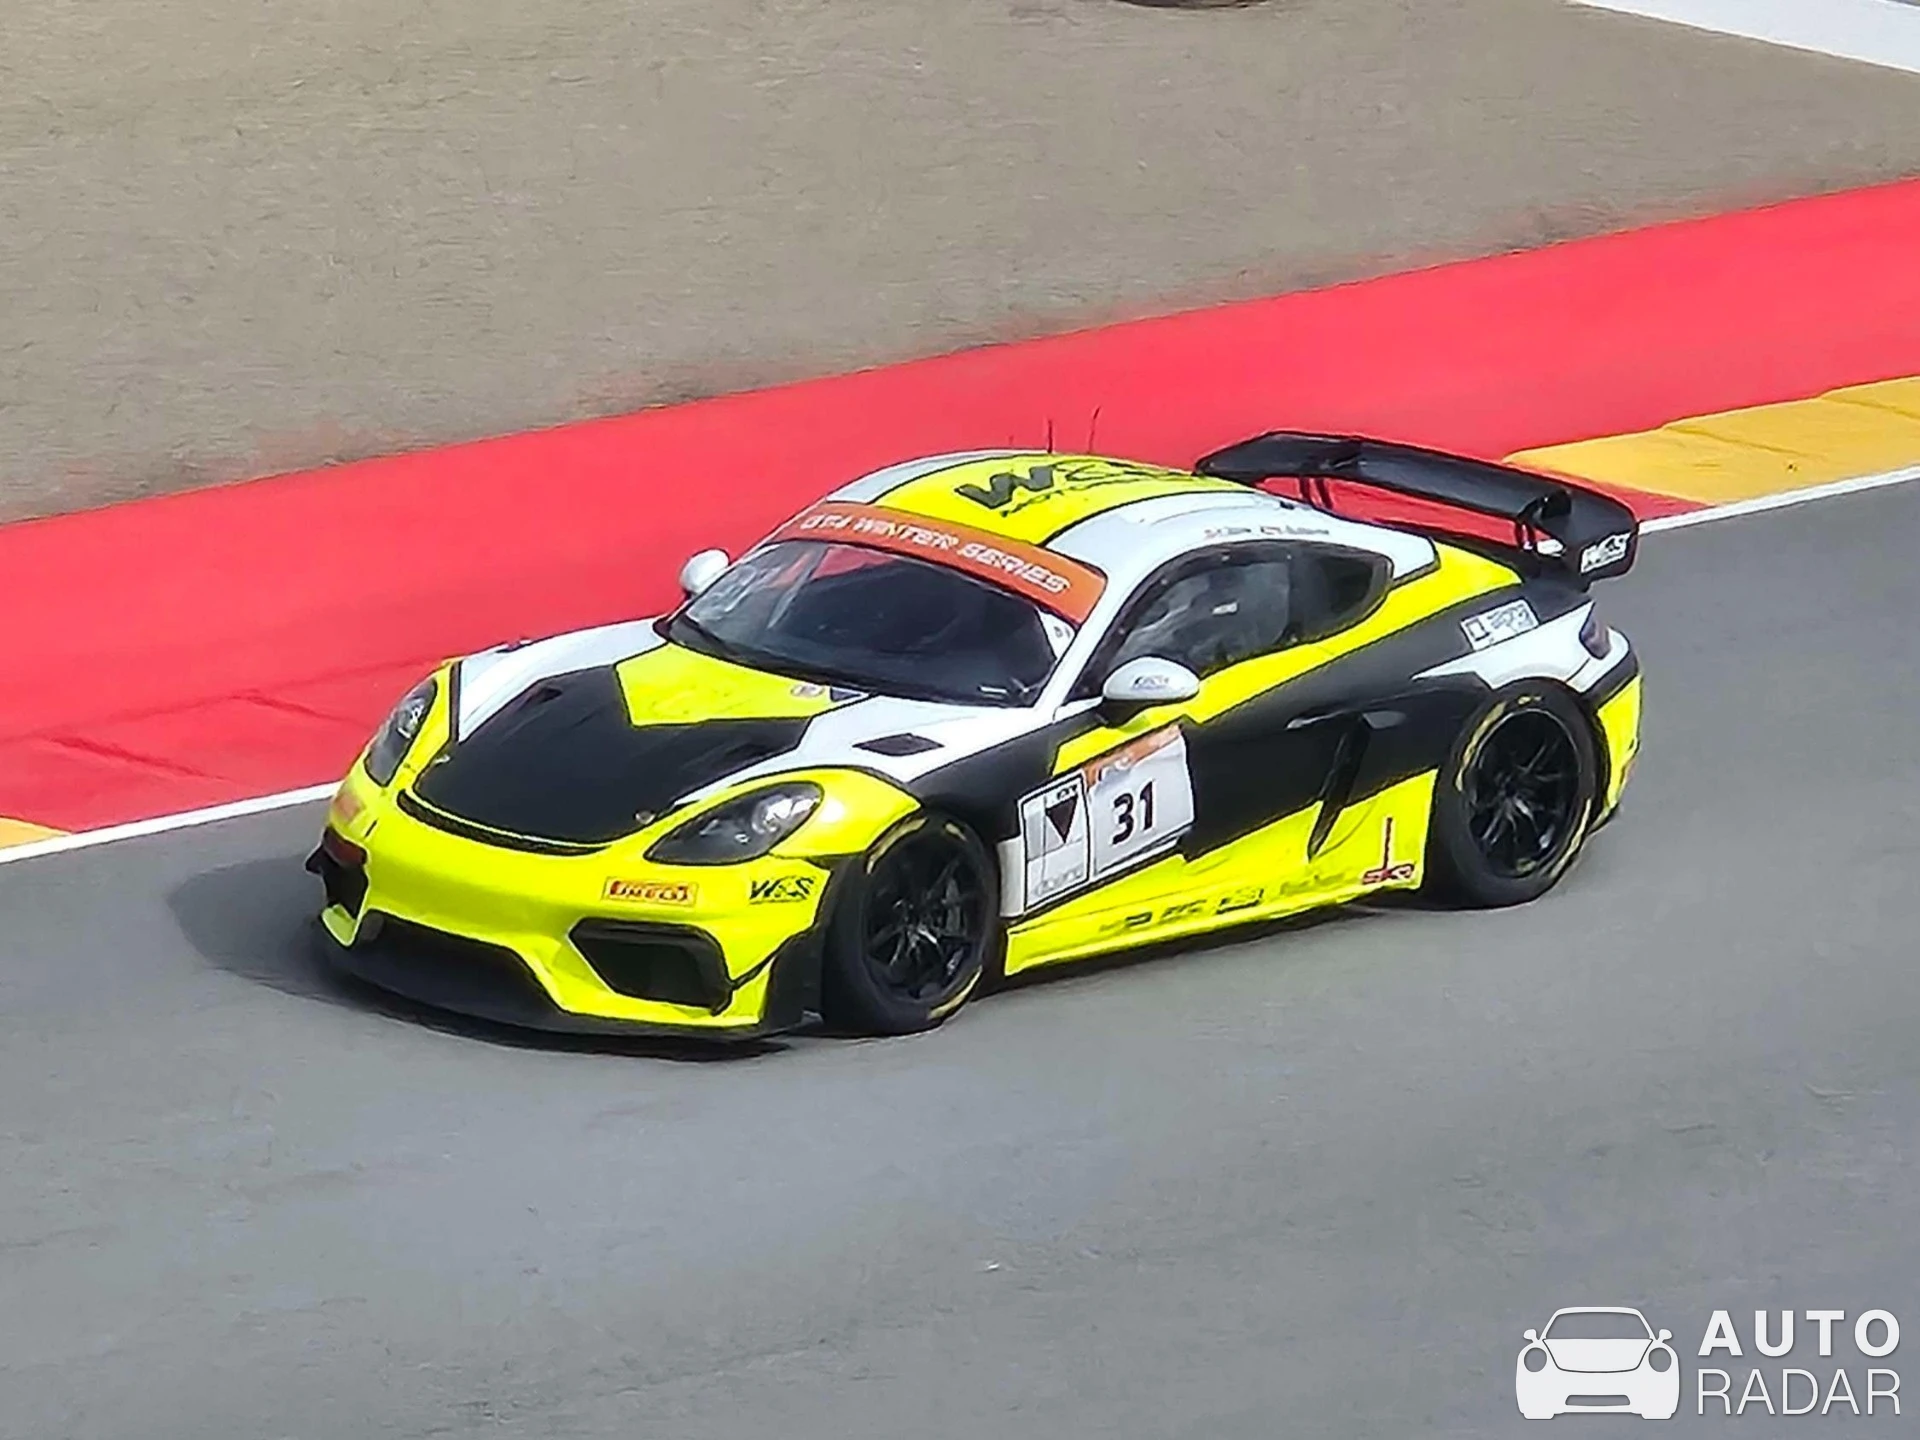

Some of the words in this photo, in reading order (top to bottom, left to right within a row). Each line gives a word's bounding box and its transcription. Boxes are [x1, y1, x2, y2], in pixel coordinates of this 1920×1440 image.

[853, 516, 959, 551] WINTER
[958, 542, 1071, 595] SERIES
[1112, 779, 1155, 845] 31
